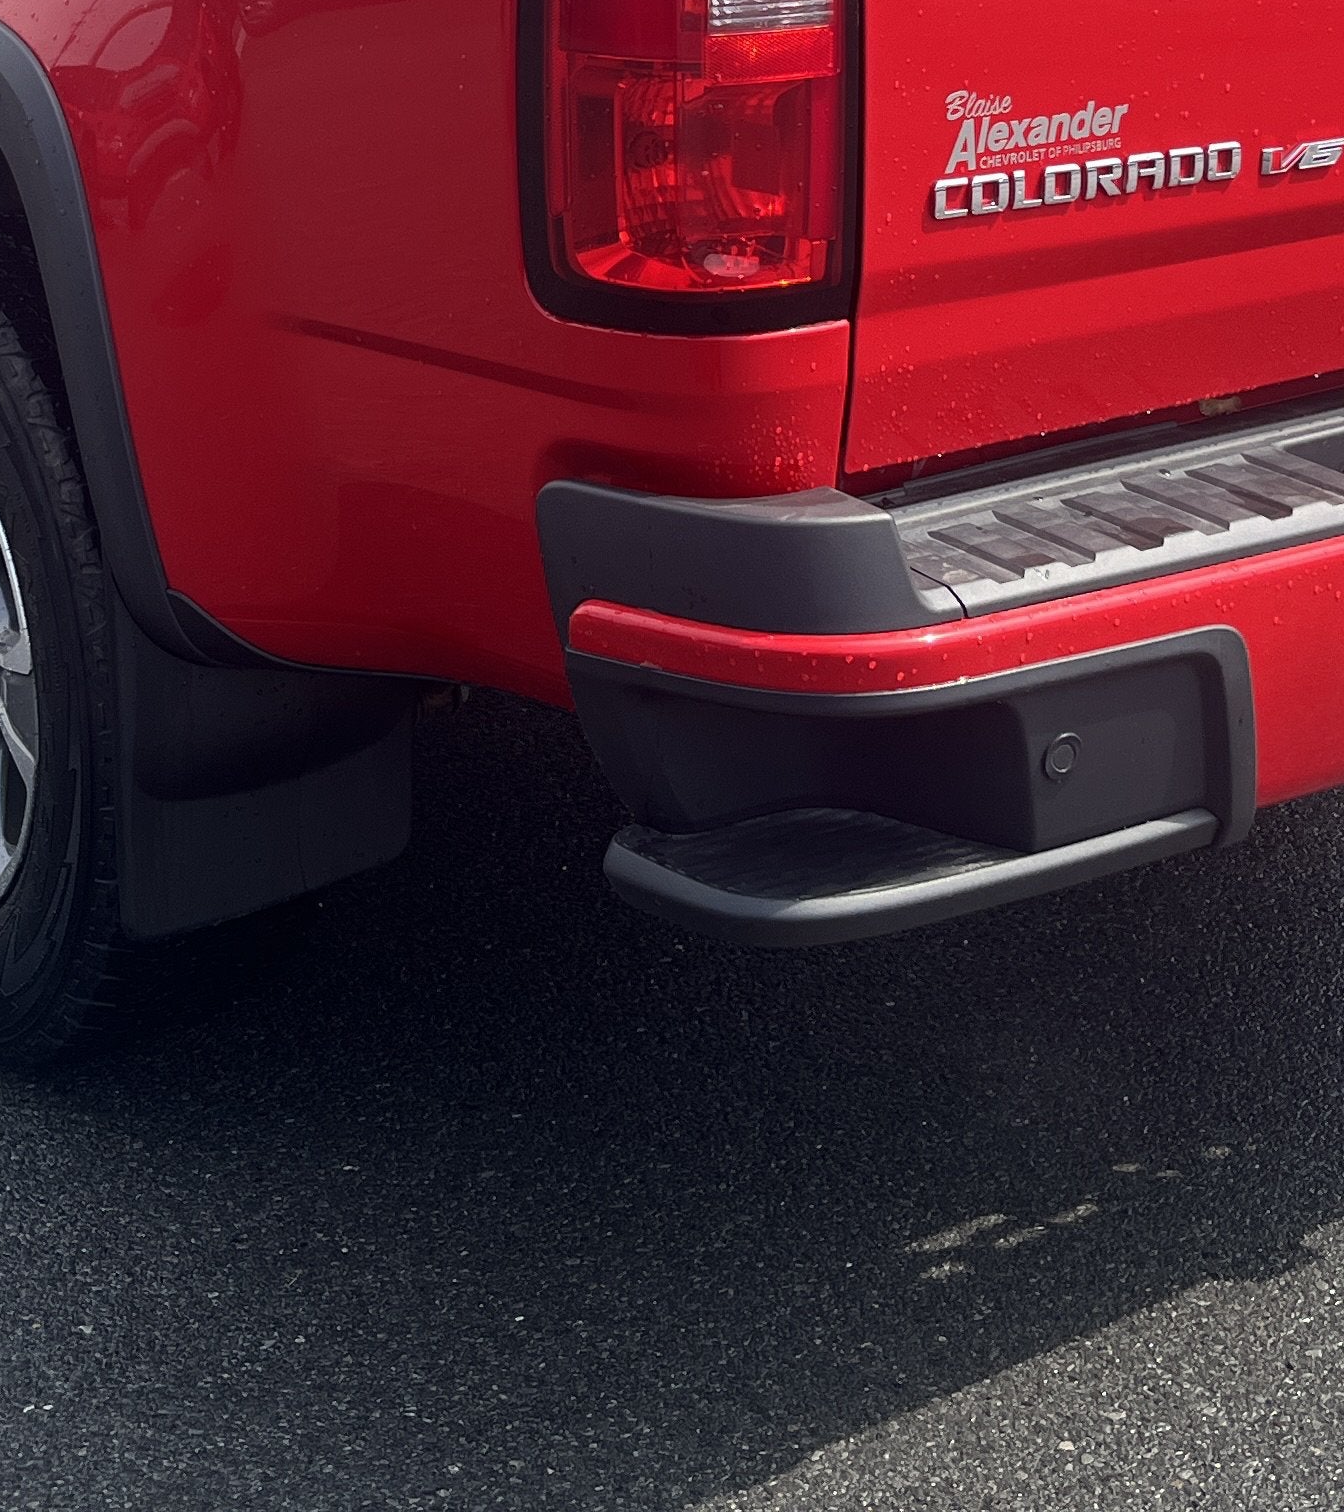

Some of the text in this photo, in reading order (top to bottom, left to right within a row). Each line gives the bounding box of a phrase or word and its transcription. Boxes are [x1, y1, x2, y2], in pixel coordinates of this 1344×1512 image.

[945, 90, 1013, 121] Blaise
[944, 100, 1129, 175] Alexander
[980, 148, 1047, 169] CHEVROLET
[1048, 146, 1062, 159] OF
[934, 141, 1241, 220] COLORADO
